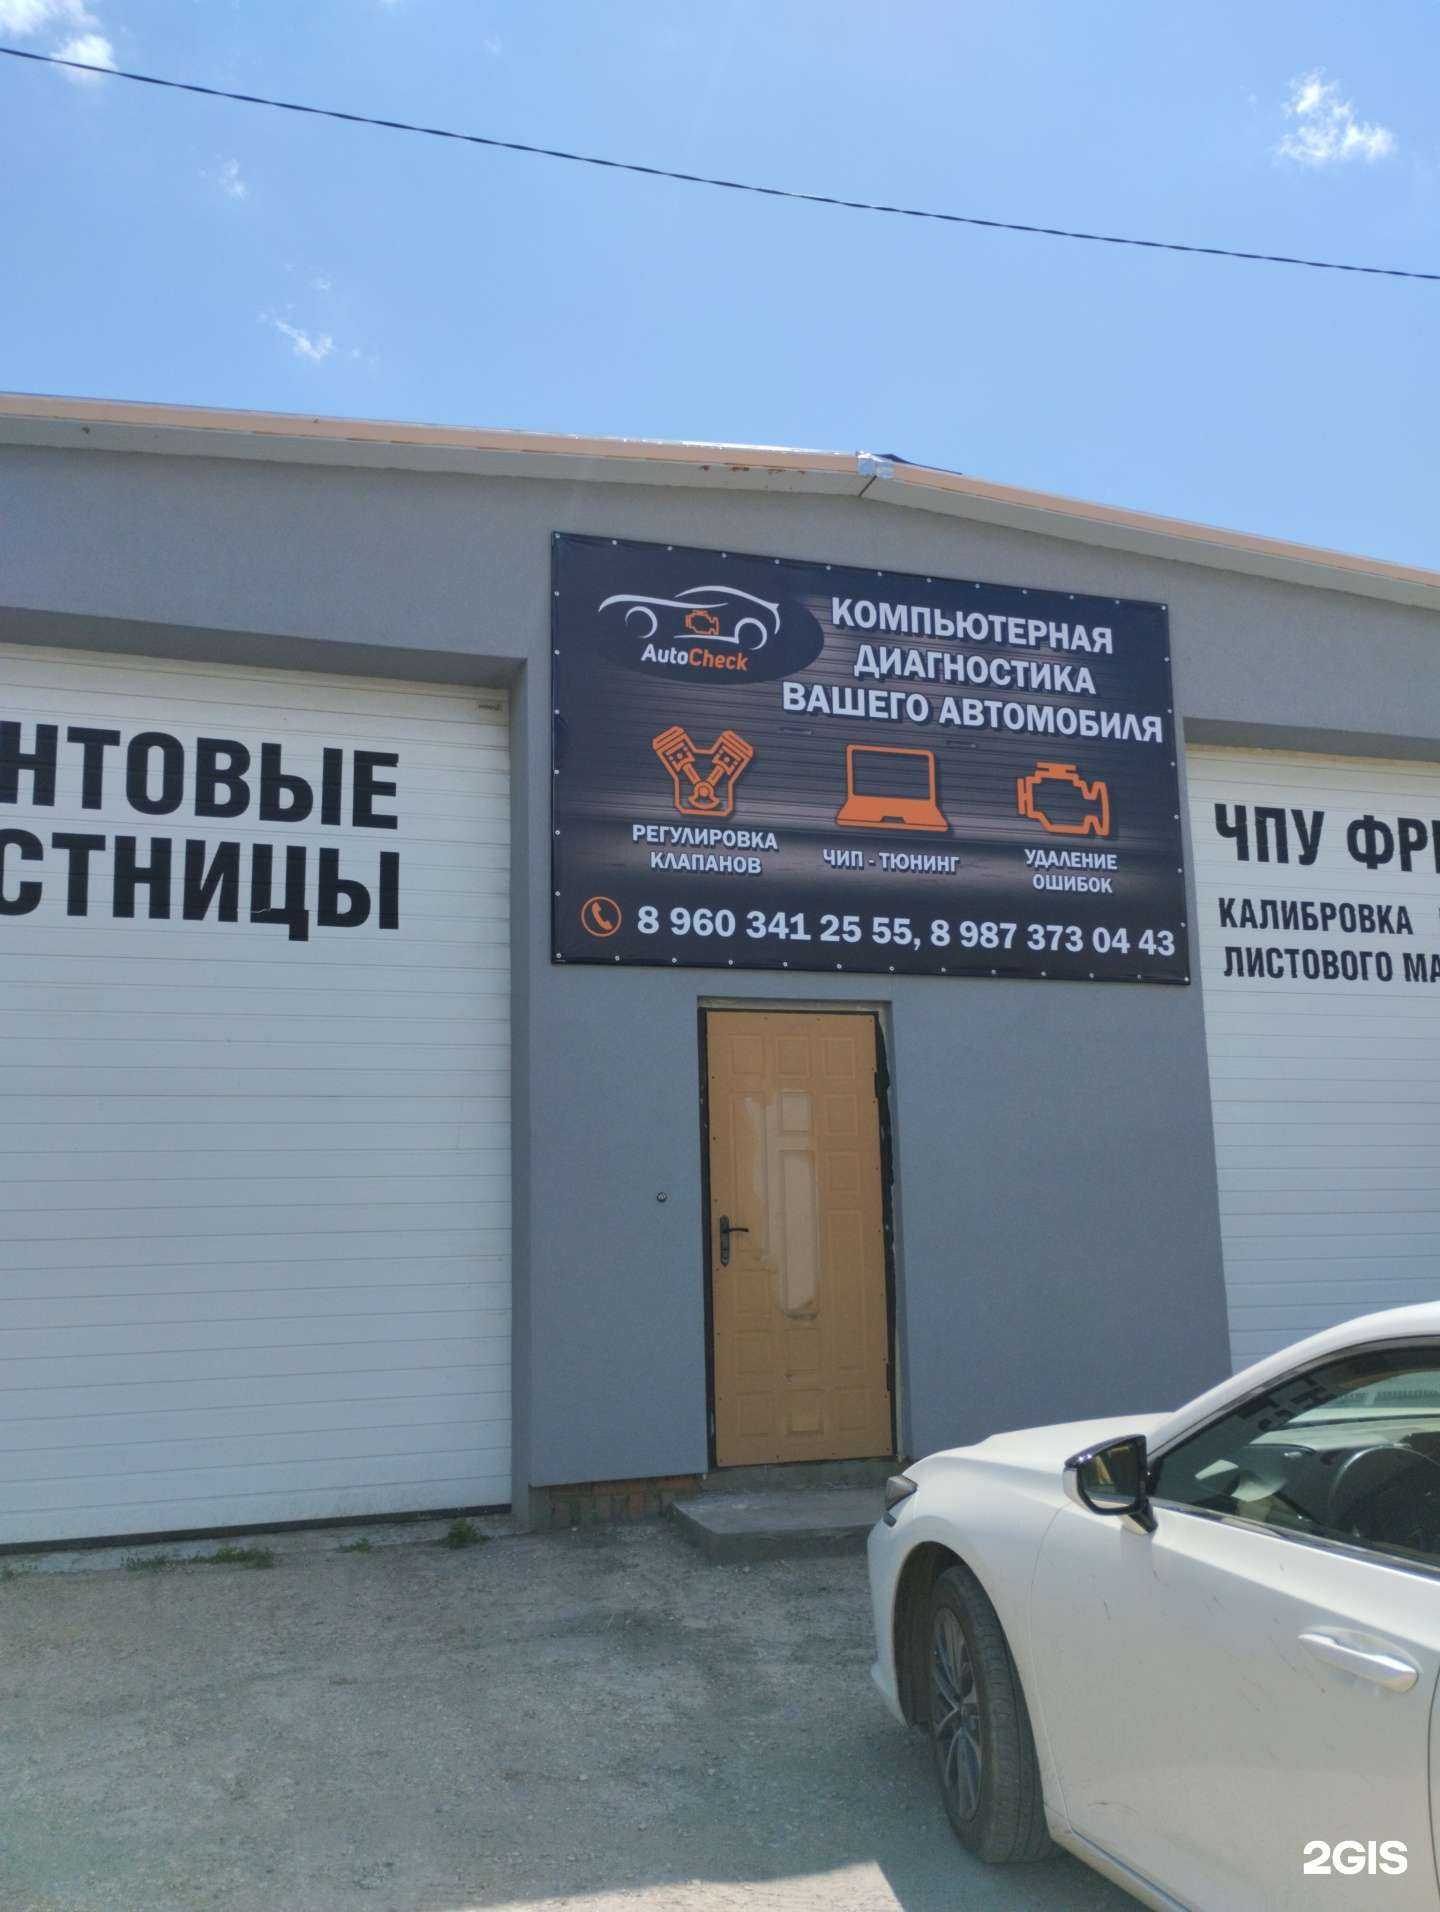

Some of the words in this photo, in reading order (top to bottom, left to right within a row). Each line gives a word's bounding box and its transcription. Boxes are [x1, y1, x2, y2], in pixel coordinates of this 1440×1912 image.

[831, 597, 1114, 655] КОМПЬЮТЕРНАЯ
[640, 643, 749, 672] AutoCheck
[853, 644, 1097, 695] ДИАГНОСТИКА
[782, 681, 930, 723] ВАШЕГО
[938, 696, 1163, 743] АВТОМОБИЛЯ
[0, 720, 399, 830] НТОВЫЕ
[632, 824, 778, 850] РЕГУЛИРОВКА
[1214, 803, 1325, 866] ЧПУ
[650, 852, 762, 874] КЛАПАНОВ
[823, 848, 863, 868] ЧИП
[878, 852, 960, 874] ТЮНИНГ
[1024, 848, 1118, 870] УДАЛЕНИЕ
[0, 828, 399, 941] СТНИЦЫ
[1032, 874, 1113, 894] ОШИБОК
[637, 905, 660, 935] 8
[670, 907, 736, 938] 960
[746, 910, 811, 941] 341
[820, 914, 862, 943] 25
[872, 916, 921, 950] 55,
[930, 919, 950, 947] 8
[959, 920, 1017, 949] 987
[1027, 924, 1084, 952] 373
[1092, 927, 1130, 954] 04
[1138, 929, 1175, 957] 43
[1218, 897, 1414, 935] КАЛИБРОВКА
[1224, 946, 1393, 982] ЛИСТОВОГО
